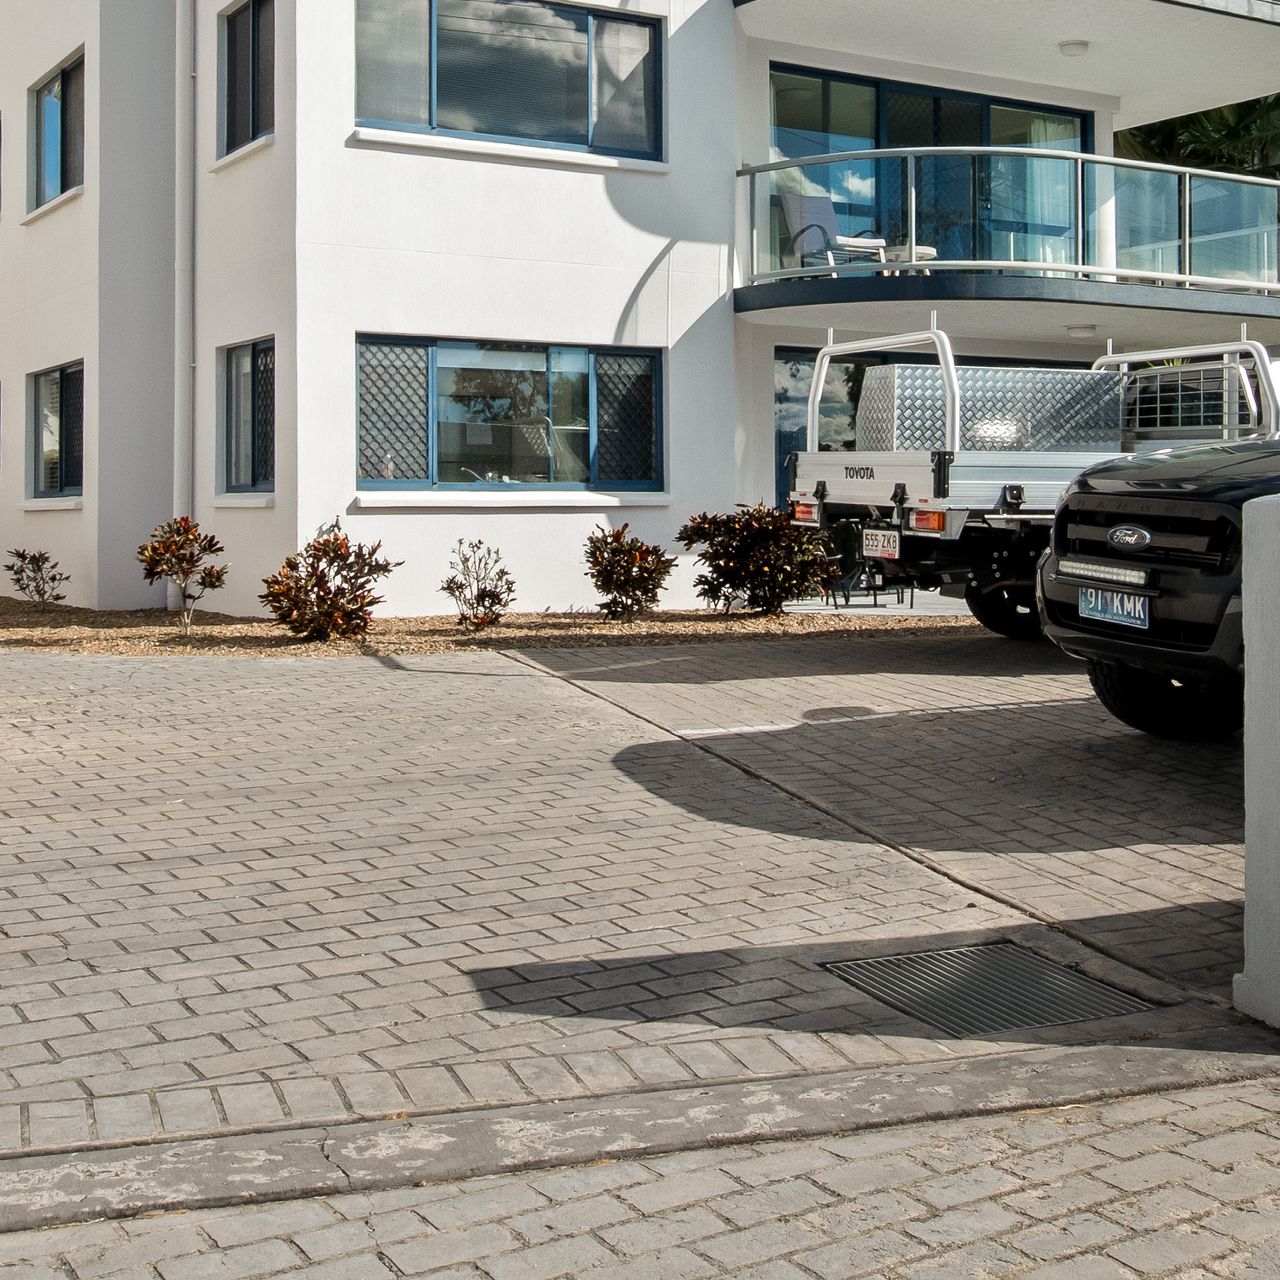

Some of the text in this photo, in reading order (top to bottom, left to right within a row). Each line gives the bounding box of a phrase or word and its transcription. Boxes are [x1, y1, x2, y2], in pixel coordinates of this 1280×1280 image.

[844, 466, 875, 480] TOYOTA
[1113, 529, 1140, 545] Ford
[1113, 592, 1145, 619] KMK
